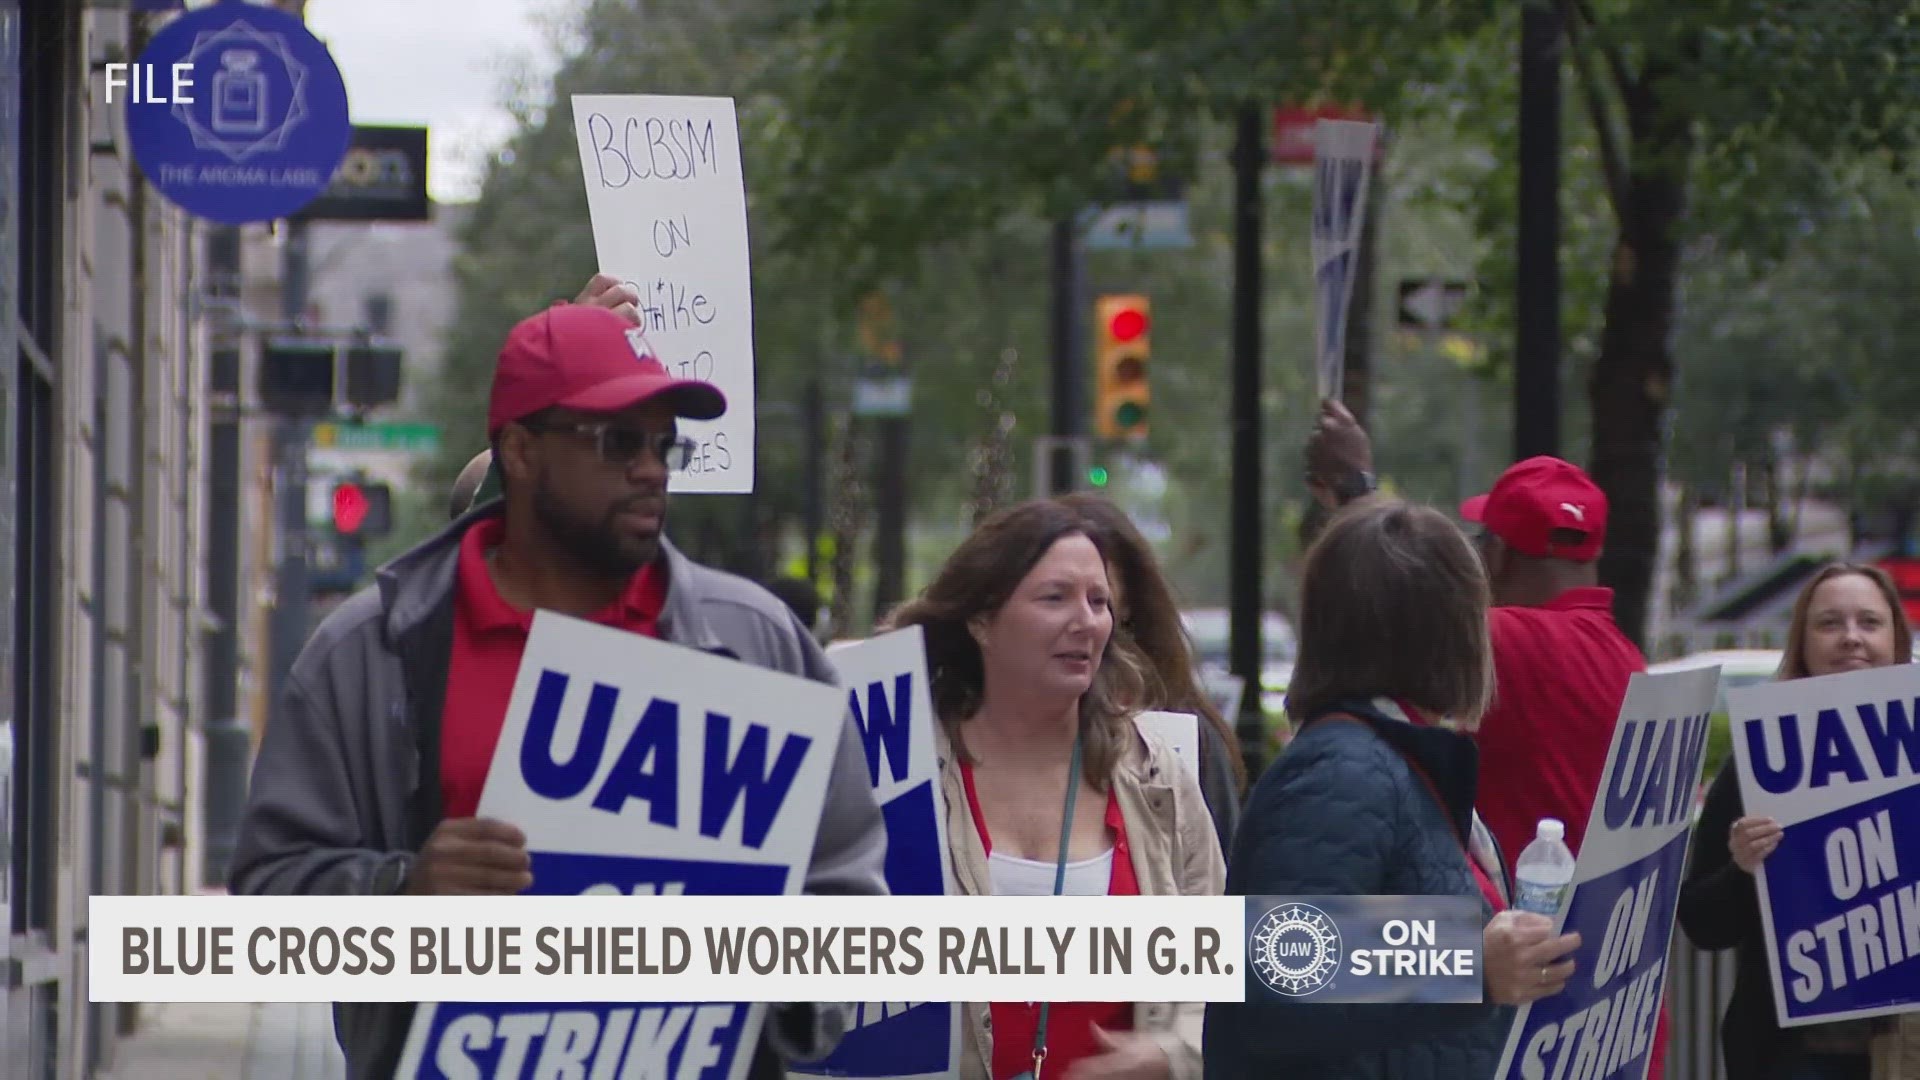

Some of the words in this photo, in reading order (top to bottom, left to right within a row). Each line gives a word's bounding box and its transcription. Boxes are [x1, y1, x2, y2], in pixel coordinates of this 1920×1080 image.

[159, 164, 193, 187] THE
[199, 165, 266, 186] AROMA
[588, 112, 717, 188] BCBSM
[653, 214, 691, 257] ON
[519, 667, 814, 850] UAW
[1603, 711, 1710, 831] UAW
[1743, 695, 1920, 795] UAW
[1825, 808, 1899, 901] ON
[1593, 866, 1660, 989] ON
[435, 1003, 737, 1080] STRIKE
[1520, 956, 1663, 1080] STRIKE
